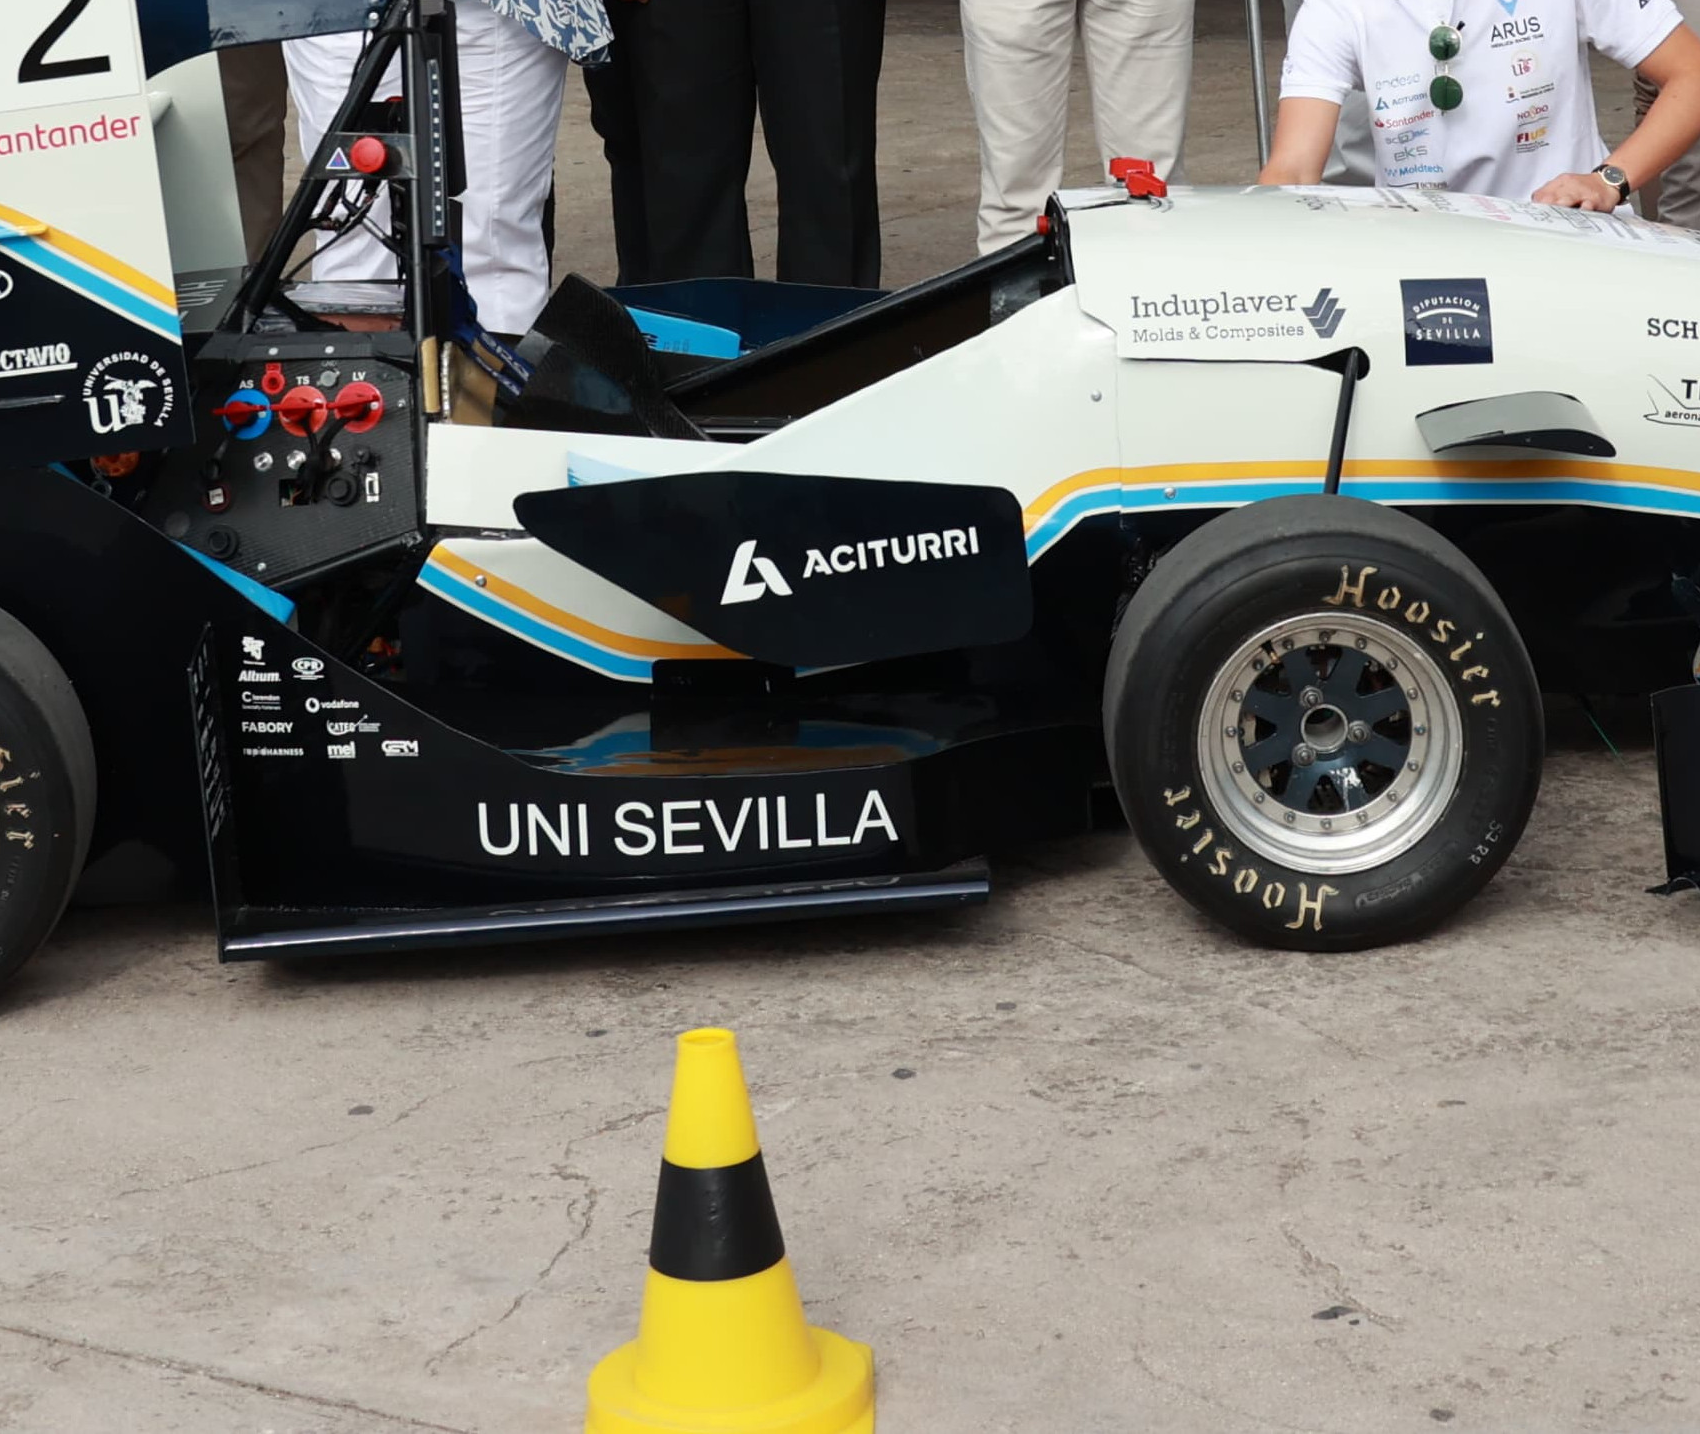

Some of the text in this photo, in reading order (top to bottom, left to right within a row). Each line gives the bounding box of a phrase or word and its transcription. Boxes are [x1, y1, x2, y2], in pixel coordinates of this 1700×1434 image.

[1491, 16, 1541, 42] ARUS
[1386, 109, 1435, 129] Santander
[1517, 127, 1548, 143] FIUS
[1399, 164, 1443, 177] Moldtech
[1131, 291, 1297, 322] Induplaver
[1132, 322, 1305, 344] Molds & Composites
[1416, 328, 1480, 341] SEVILLA
[239, 379, 254, 390] AS
[296, 376, 310, 386] TS
[352, 371, 366, 382] LV
[82, 351, 174, 427] UNIVERSIDAD DE SEVILLA
[802, 526, 980, 579] ACITURRI
[1322, 564, 1502, 709] Hoosier
[241, 721, 293, 733] FABORY
[477, 789, 899, 857] UNI SEVILLA
[1163, 784, 1340, 932] Hoosier
